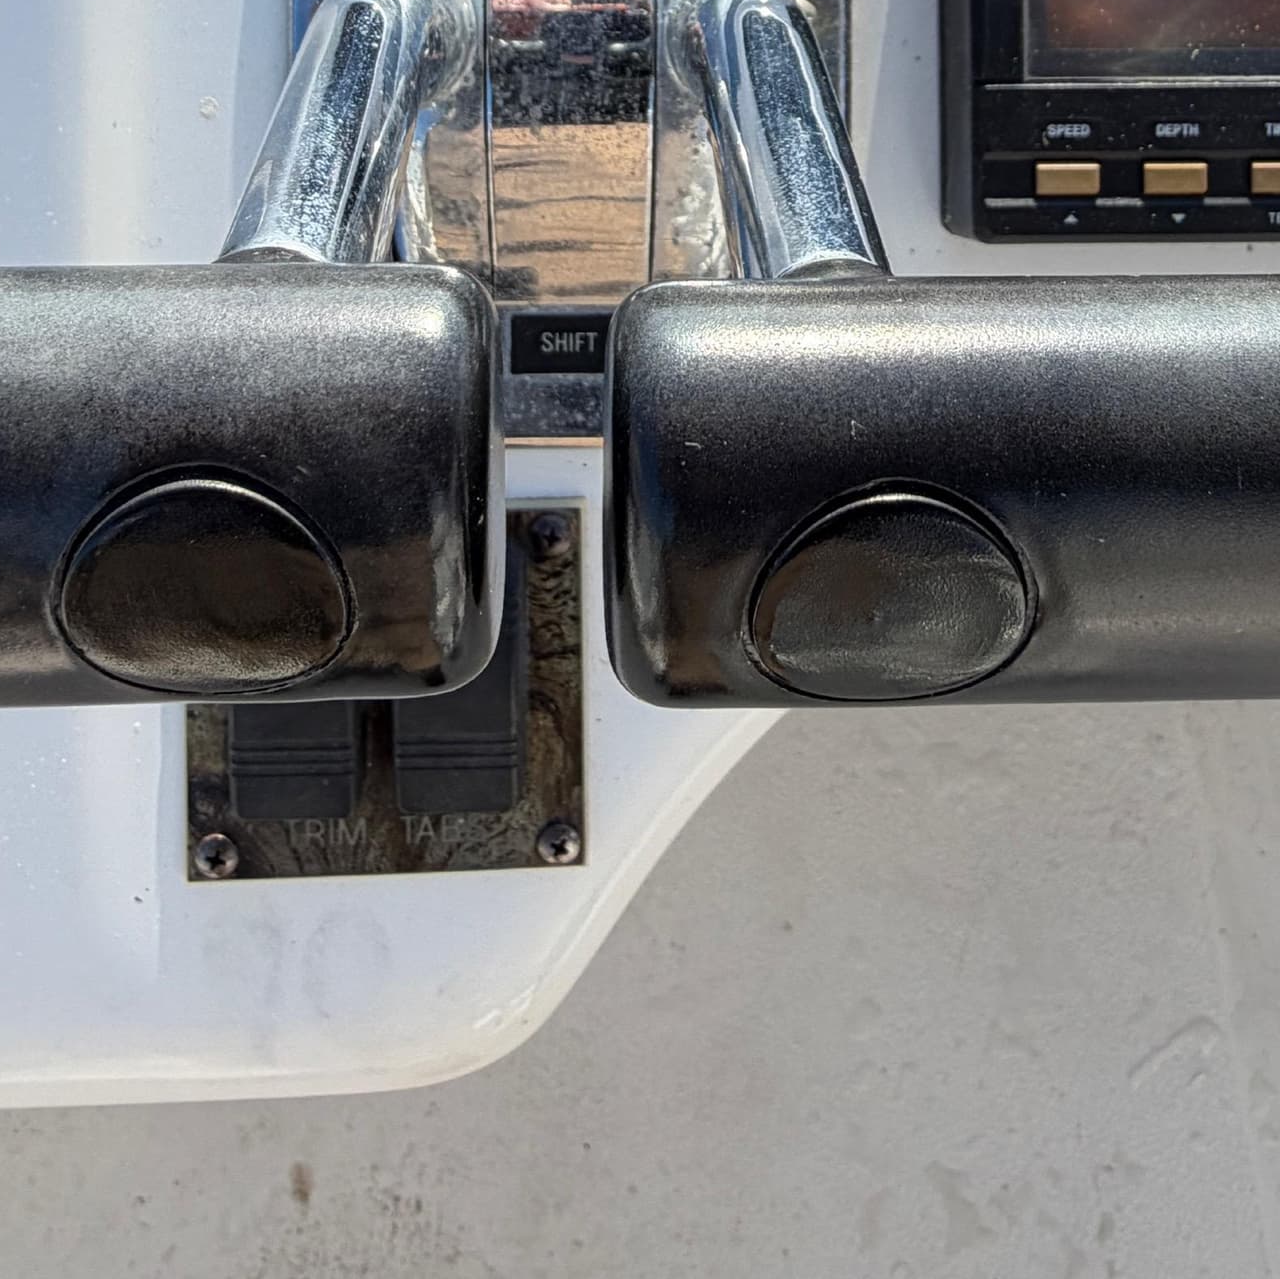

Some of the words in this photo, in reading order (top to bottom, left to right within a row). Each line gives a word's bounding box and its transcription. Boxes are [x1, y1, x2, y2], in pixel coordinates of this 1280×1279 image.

[1047, 123, 1091, 138] SPEED
[1155, 122, 1200, 138] DEPTH
[541, 331, 598, 353] SHIFT
[286, 818, 368, 846] TRIM
[401, 815, 488, 844] TABS
